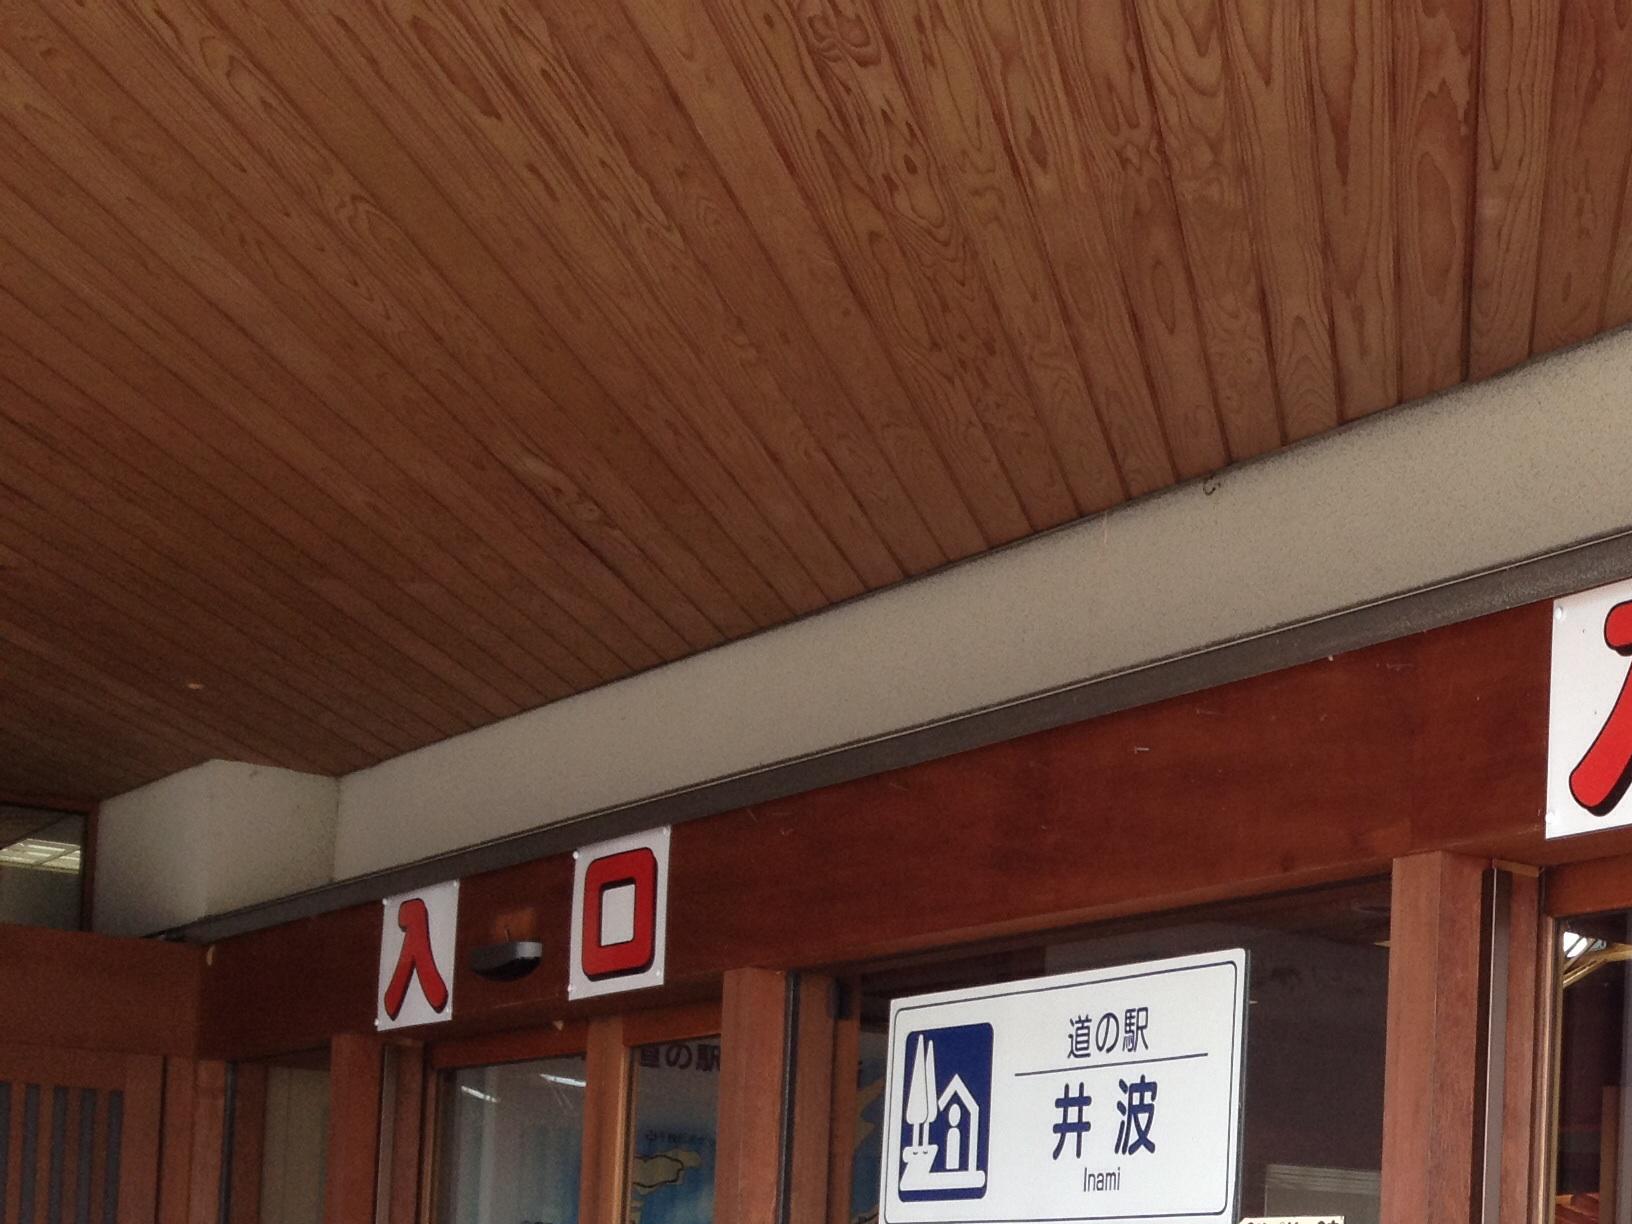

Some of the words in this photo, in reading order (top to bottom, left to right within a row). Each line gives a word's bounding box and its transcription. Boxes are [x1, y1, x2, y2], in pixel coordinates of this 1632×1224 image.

[1067, 1007, 1149, 1059] 道の駅
[1052, 1074, 1158, 1160] 井波
[1084, 1166, 1120, 1192] Inami
